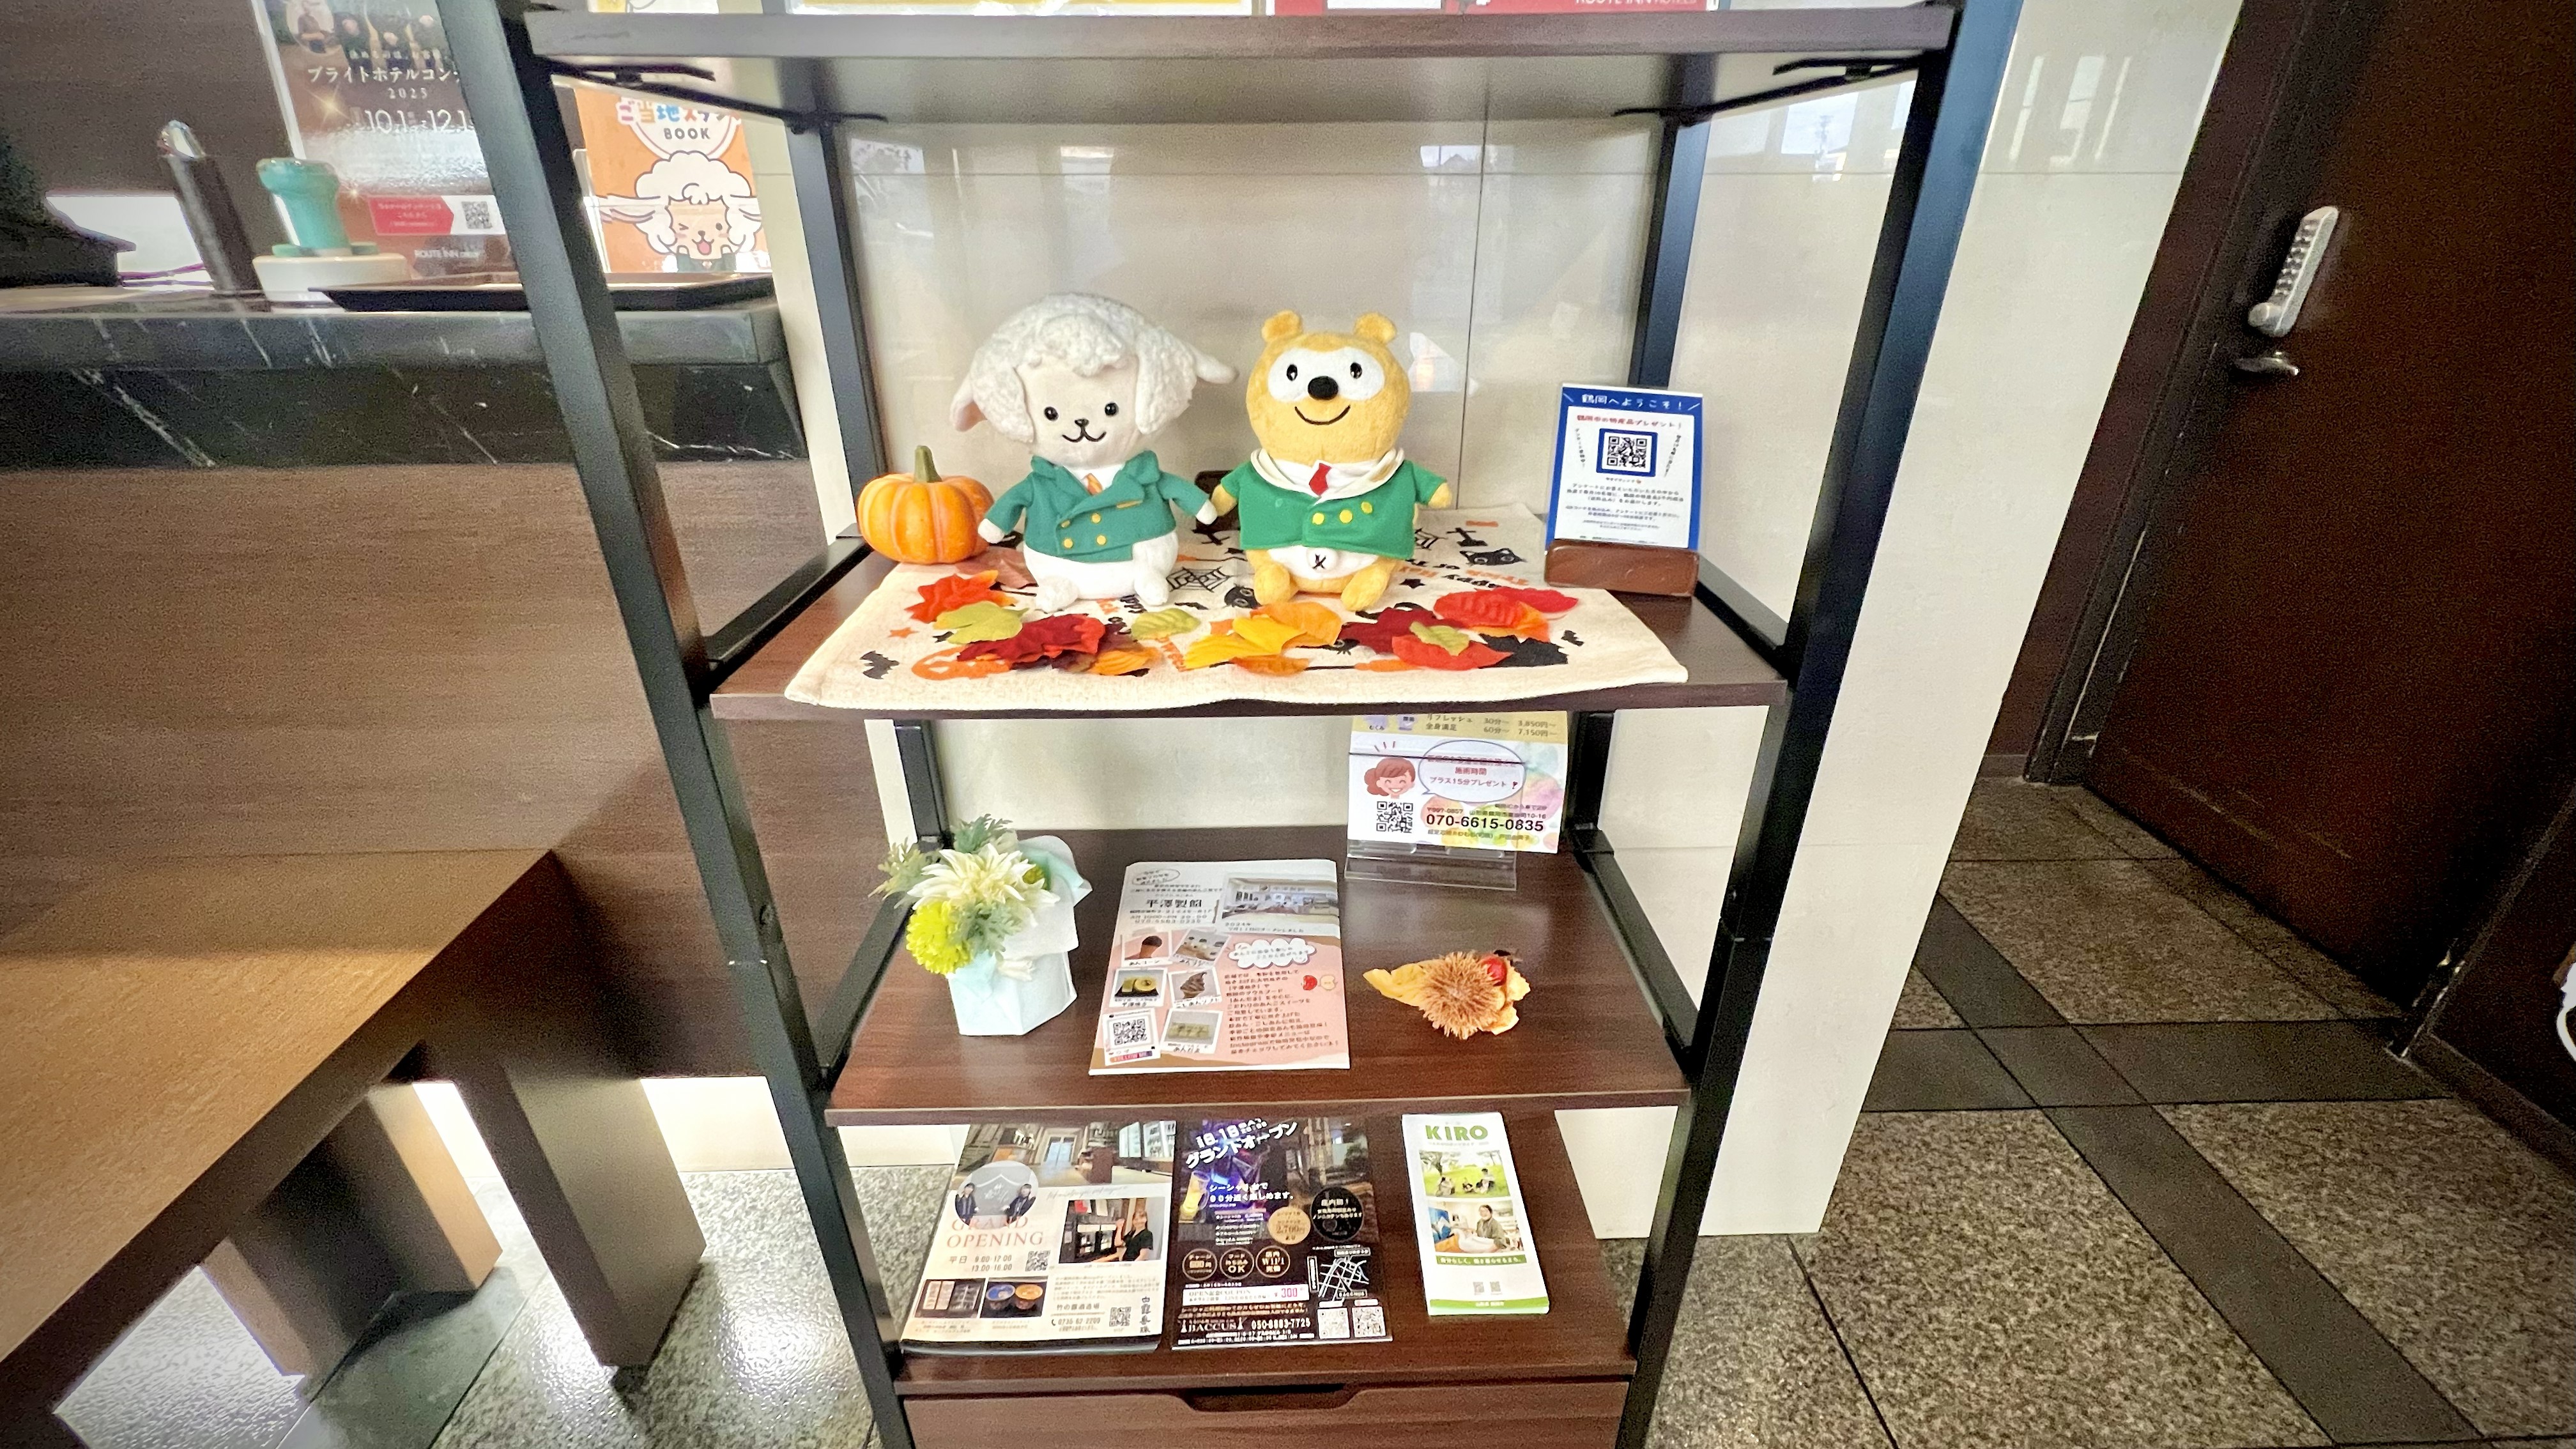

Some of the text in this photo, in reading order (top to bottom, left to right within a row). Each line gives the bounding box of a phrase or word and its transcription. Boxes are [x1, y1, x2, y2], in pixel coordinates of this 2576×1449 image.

[388, 87, 429, 100] 2025
[663, 127, 711, 140] BOOK
[1425, 723, 1457, 732] 全身満足
[1426, 813, 1544, 832] 070-6615-0835
[1425, 1124, 1489, 1141] KIRO
[1185, 1121, 1298, 1169] グランドオープン
[946, 1231, 1044, 1248] OPENING
[949, 1255, 968, 1264] 平日
[1227, 1265, 1246, 1273] OK
[1281, 1287, 1298, 1298] 300
